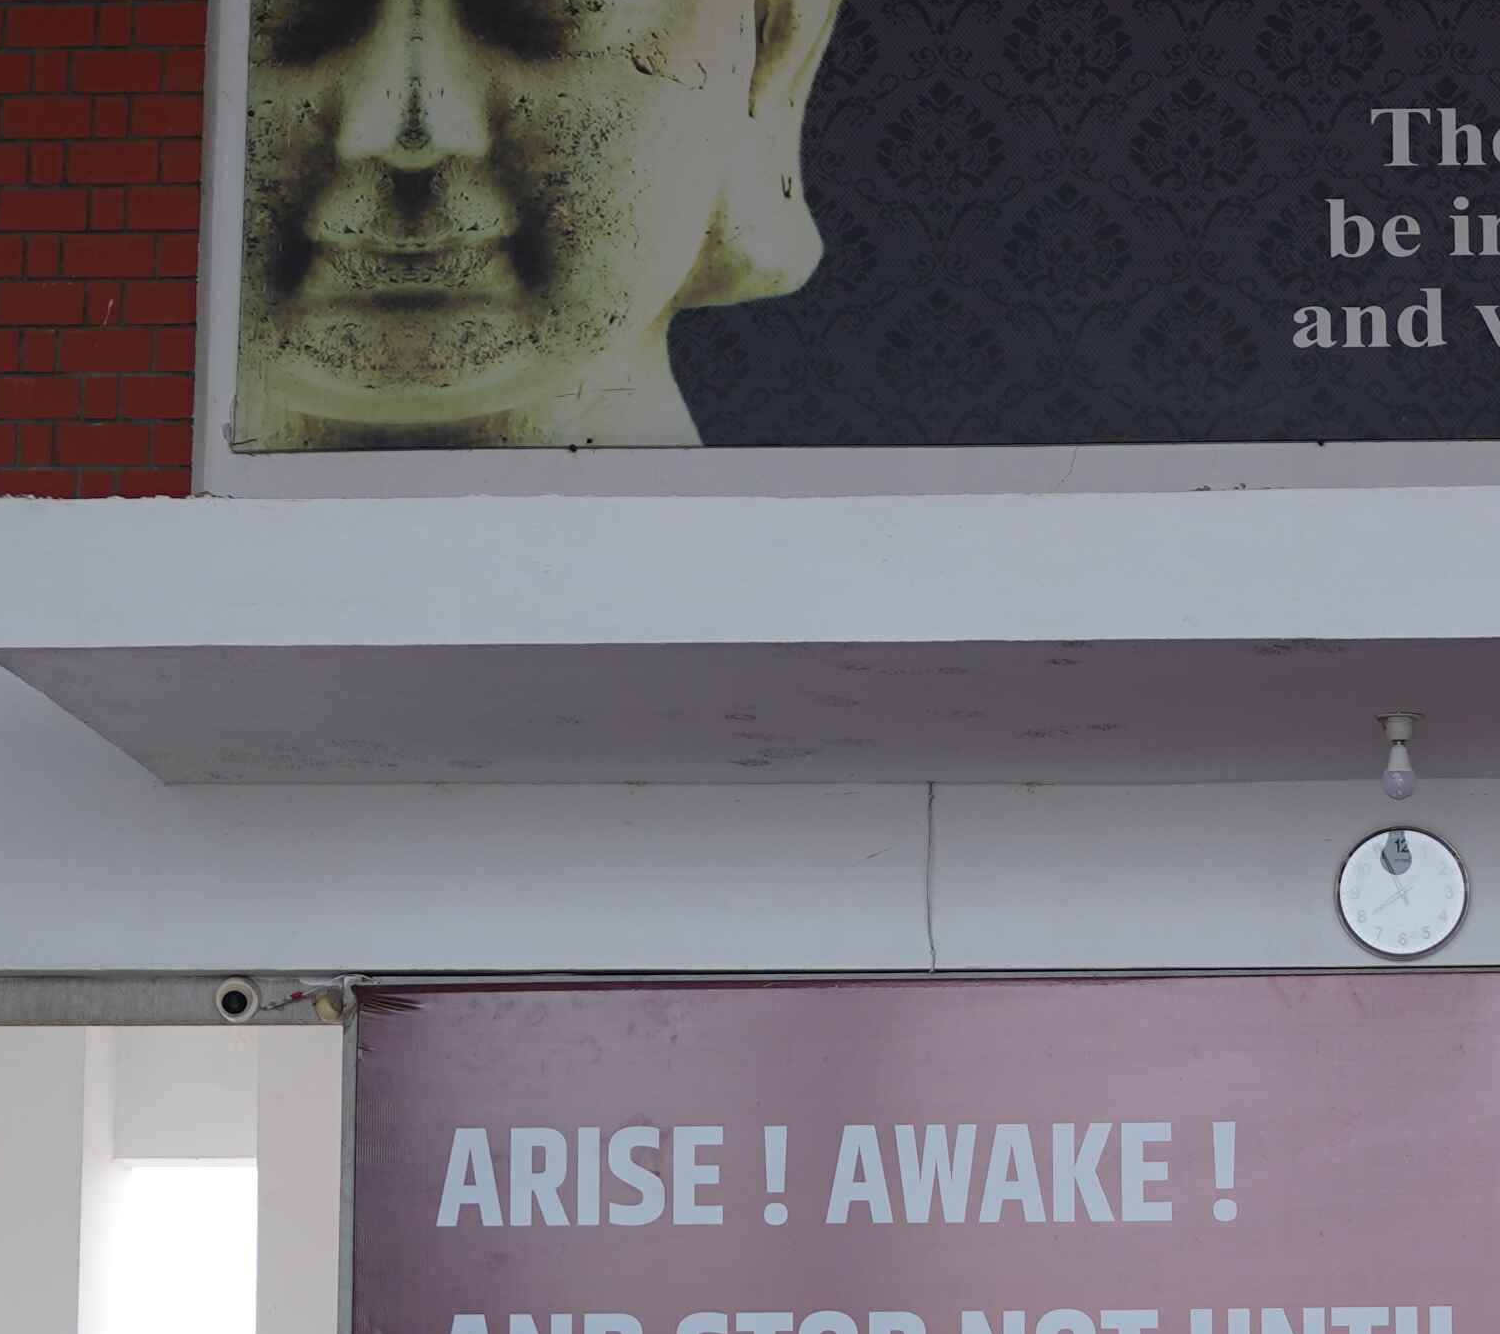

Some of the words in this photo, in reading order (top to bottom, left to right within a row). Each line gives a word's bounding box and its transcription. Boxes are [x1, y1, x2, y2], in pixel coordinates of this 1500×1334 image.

[1325, 198, 1421, 258] be
[1292, 287, 1447, 349] and
[1444, 885, 1454, 900] 3
[1357, 909, 1367, 923] 8
[1421, 925, 1431, 940] 5
[436, 1125, 724, 1227] ARISE
[763, 1125, 789, 1226] !
[825, 1121, 1173, 1224] AWAKE
[1211, 1120, 1239, 1223] !
